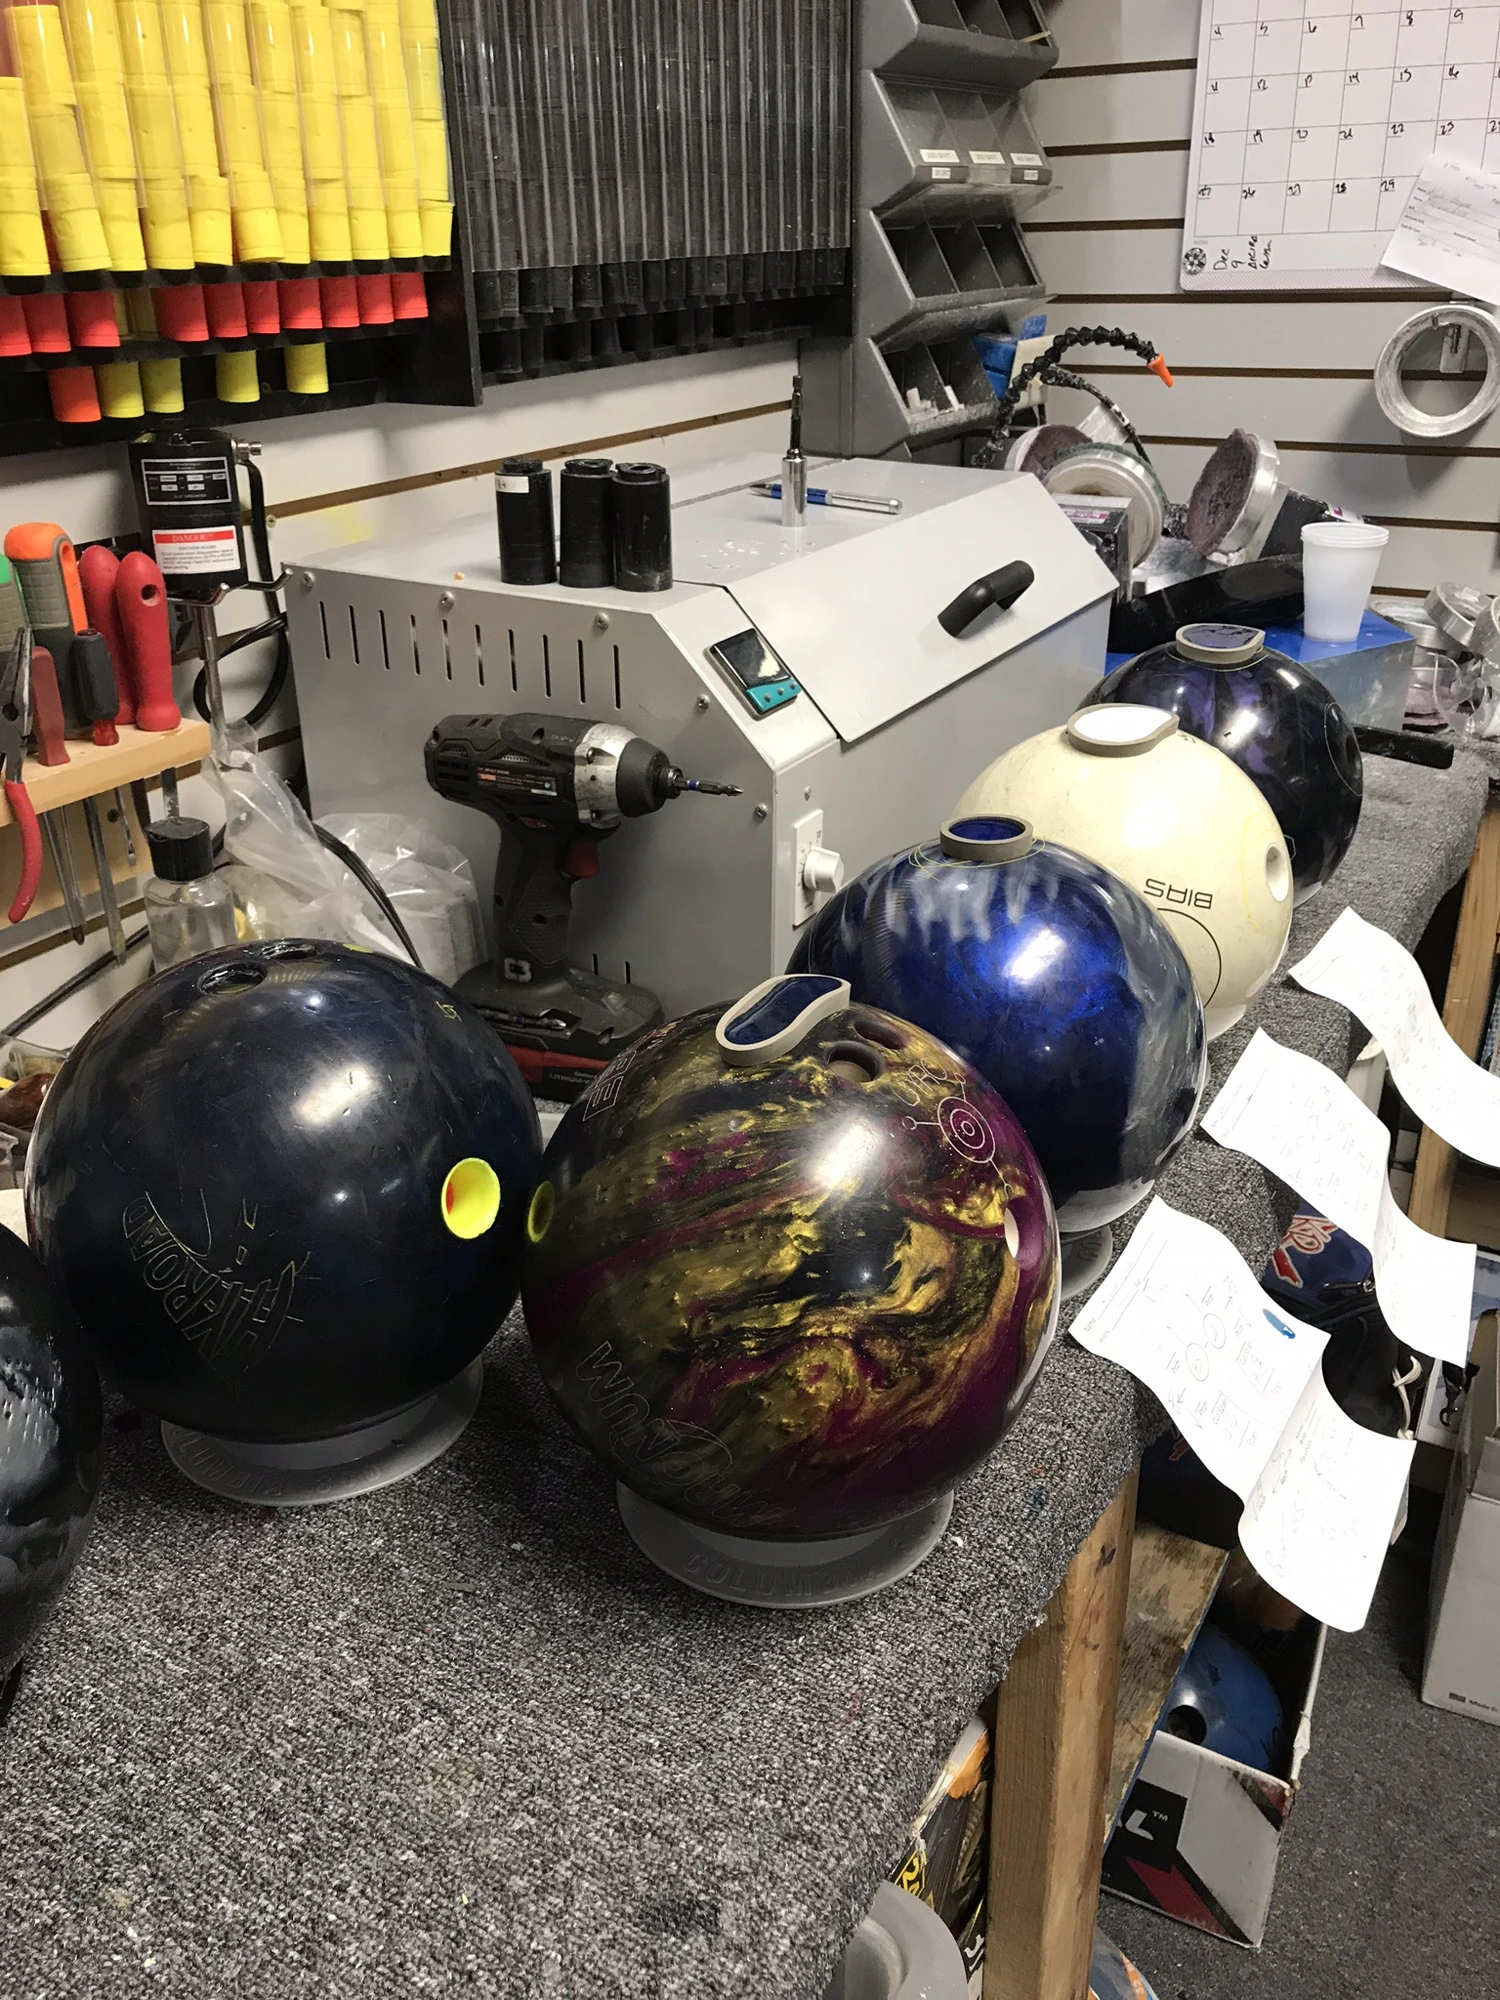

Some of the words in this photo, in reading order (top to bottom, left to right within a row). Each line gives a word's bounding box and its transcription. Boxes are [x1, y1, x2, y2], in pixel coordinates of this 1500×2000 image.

[1260, 21, 1268, 35] 5
[1355, 15, 1364, 27] 7
[1406, 10, 1413, 26] 8
[1349, 72, 1360, 83] 14
[1400, 68, 1412, 82] 15
[1391, 123, 1404, 134] 22
[1441, 121, 1455, 135] 23
[1288, 183, 1301, 195] 27
[1380, 179, 1395, 192] 29
[1143, 878, 1213, 909] BIAS
